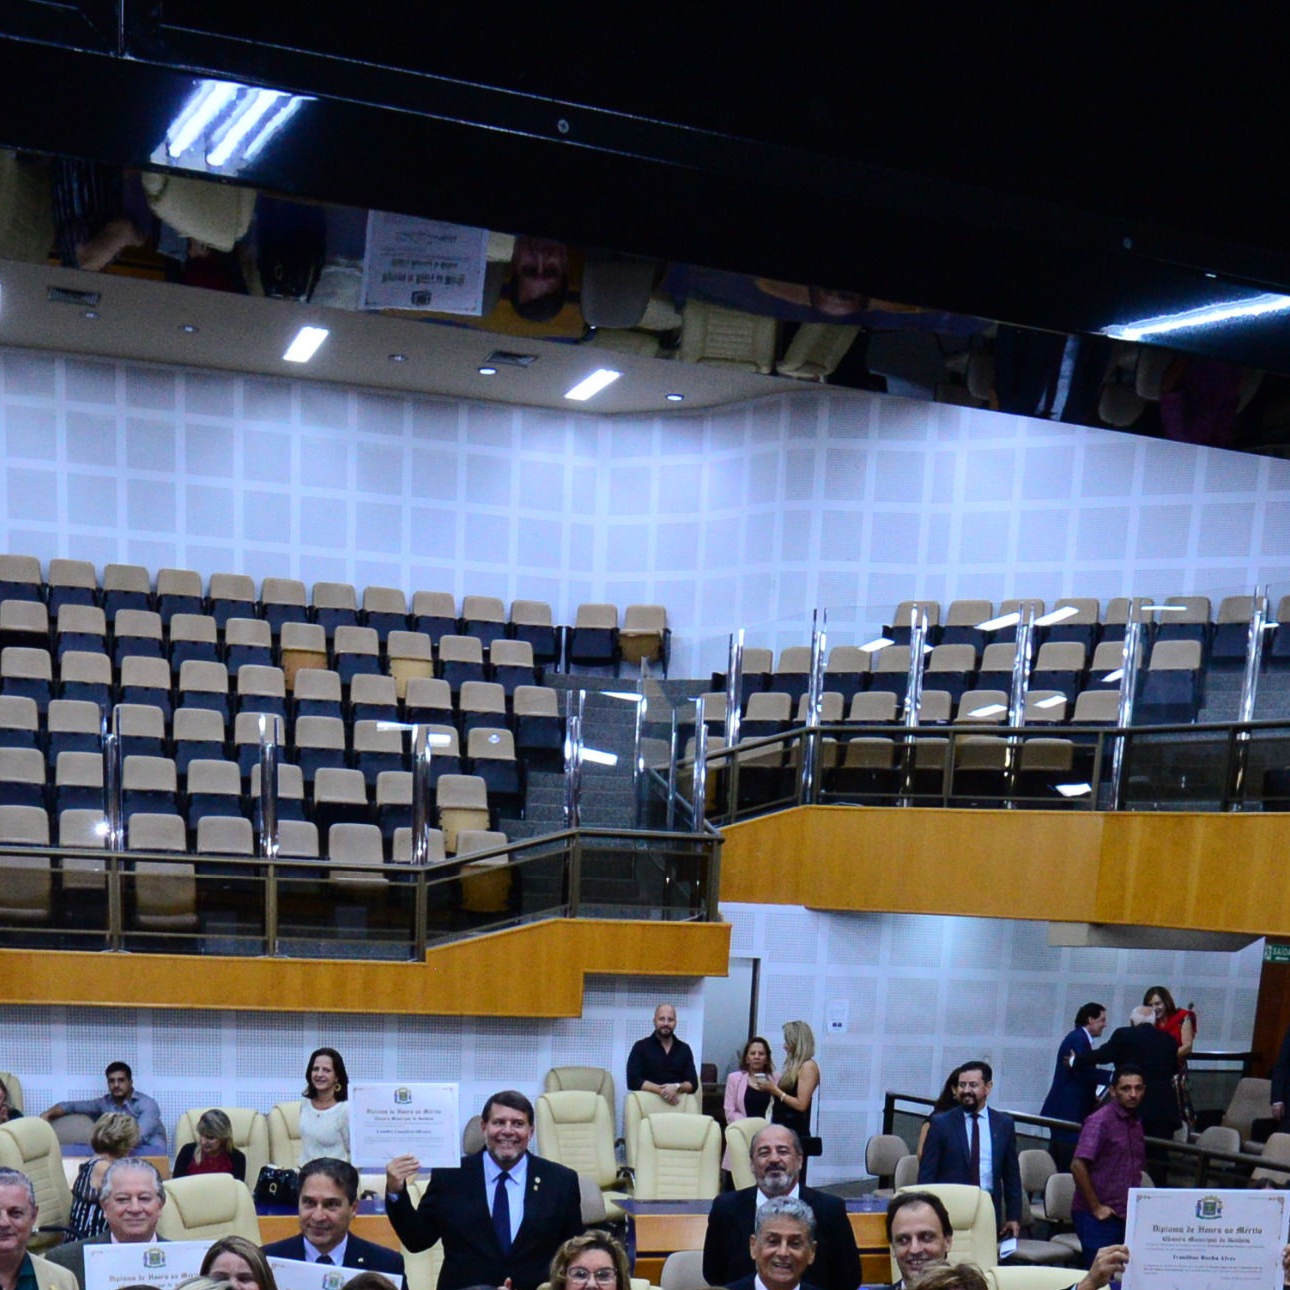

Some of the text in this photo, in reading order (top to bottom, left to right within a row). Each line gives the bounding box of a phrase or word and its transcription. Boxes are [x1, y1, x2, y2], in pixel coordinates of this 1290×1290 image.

[1152, 1224, 1184, 1233] Diploma
[1186, 1225, 1194, 1233] de
[1197, 1225, 1222, 1233] Honra
[1235, 1226, 1263, 1234] Mérito
